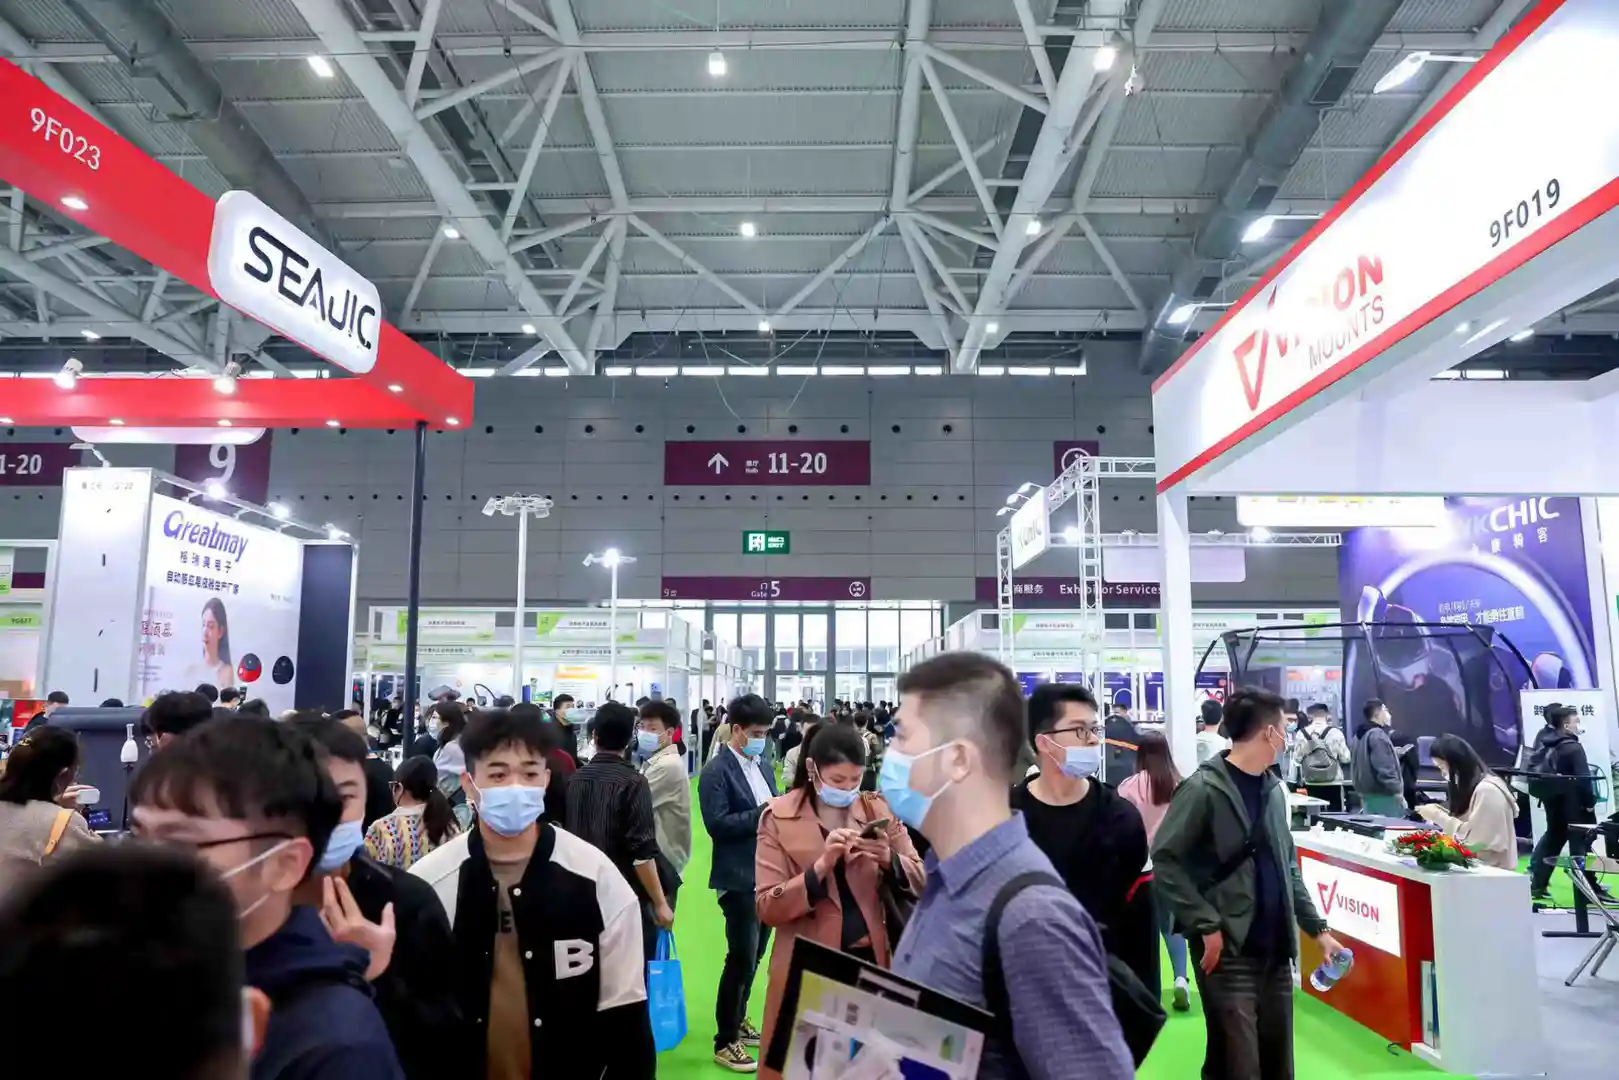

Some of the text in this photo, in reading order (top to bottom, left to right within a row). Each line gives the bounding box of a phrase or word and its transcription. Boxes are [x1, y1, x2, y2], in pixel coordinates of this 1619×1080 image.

[31, 108, 100, 170] 9F023
[1489, 178, 1560, 248] 9F019
[1308, 295, 1385, 370] MOUNTS
[208, 443, 237, 487] 9
[767, 452, 828, 474] 11-20
[163, 509, 249, 562] Greatmay
[751, 590, 768, 598] Gate
[770, 581, 781, 598] 5
[1336, 892, 1380, 922] VISION
[554, 938, 594, 980] B
